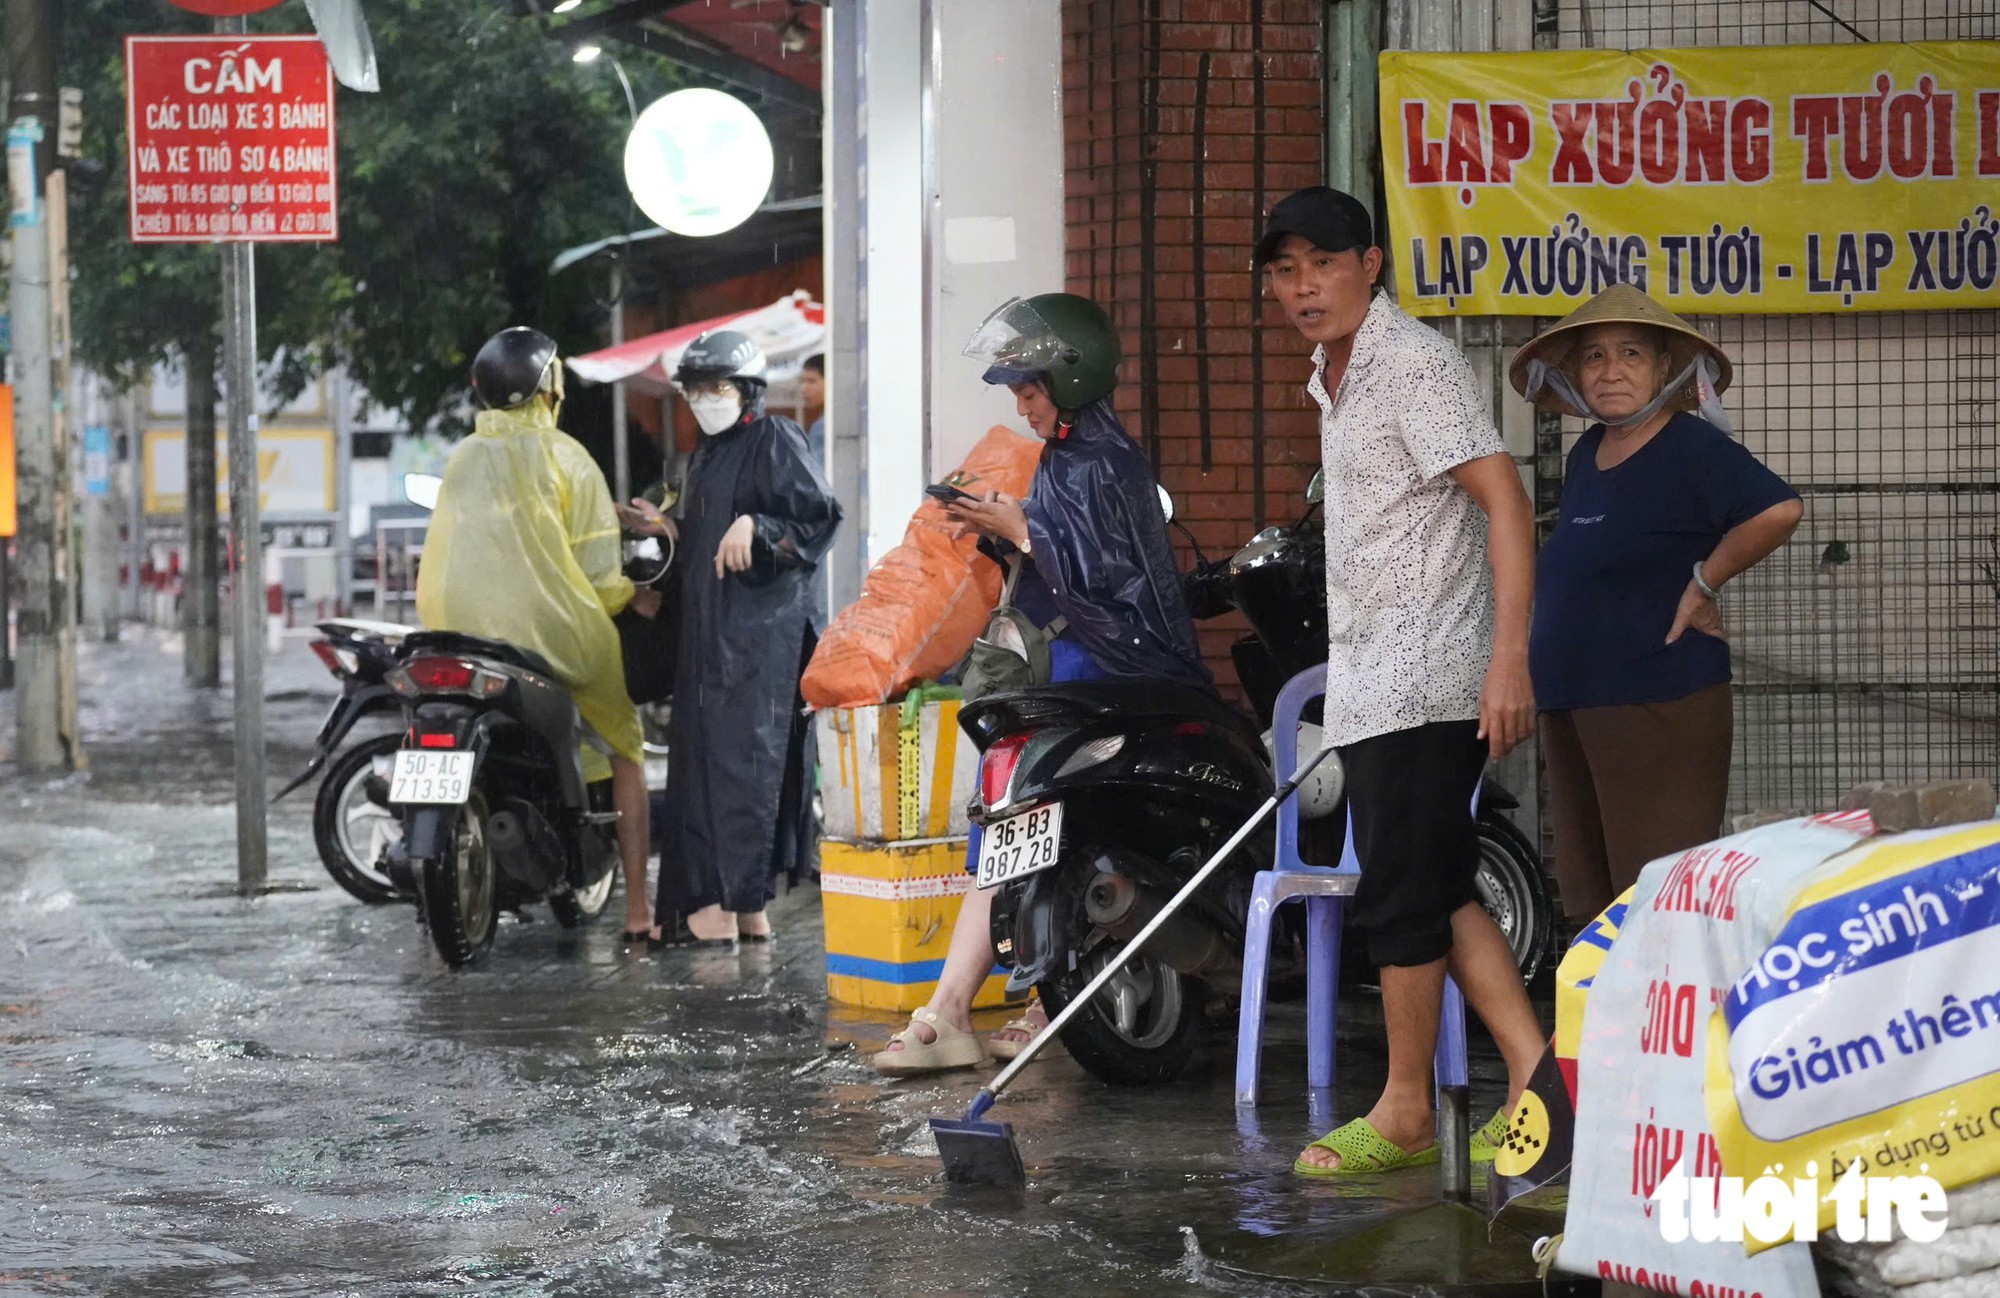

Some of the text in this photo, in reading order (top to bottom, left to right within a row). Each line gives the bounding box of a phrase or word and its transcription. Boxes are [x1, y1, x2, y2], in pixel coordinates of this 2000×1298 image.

[184, 43, 283, 94] CẤM
[146, 96, 326, 135] CÁC LOẠI XE 3 BÁNH
[1404, 103, 1530, 205] LẠP
[1552, 65, 1770, 185] XƯỞNG
[1794, 74, 1954, 180] TƯƠI
[138, 139, 329, 172] VÀ XE THÔ SƠ 4 BÁNH
[1411, 236, 1487, 307] LẠP
[1501, 213, 1646, 296] XƯỞNG
[1661, 224, 1760, 295] TƯƠI
[1808, 233, 1893, 305] LẠP
[396, 779, 461, 799] 713.59
[994, 808, 1050, 850] 36-B3
[984, 836, 1053, 881] 987.28
[1840, 886, 1949, 957] sinh
[1749, 1036, 1885, 1100] Giảm
[1876, 1131, 1950, 1168] dụng
[1953, 1115, 1985, 1142] từ
